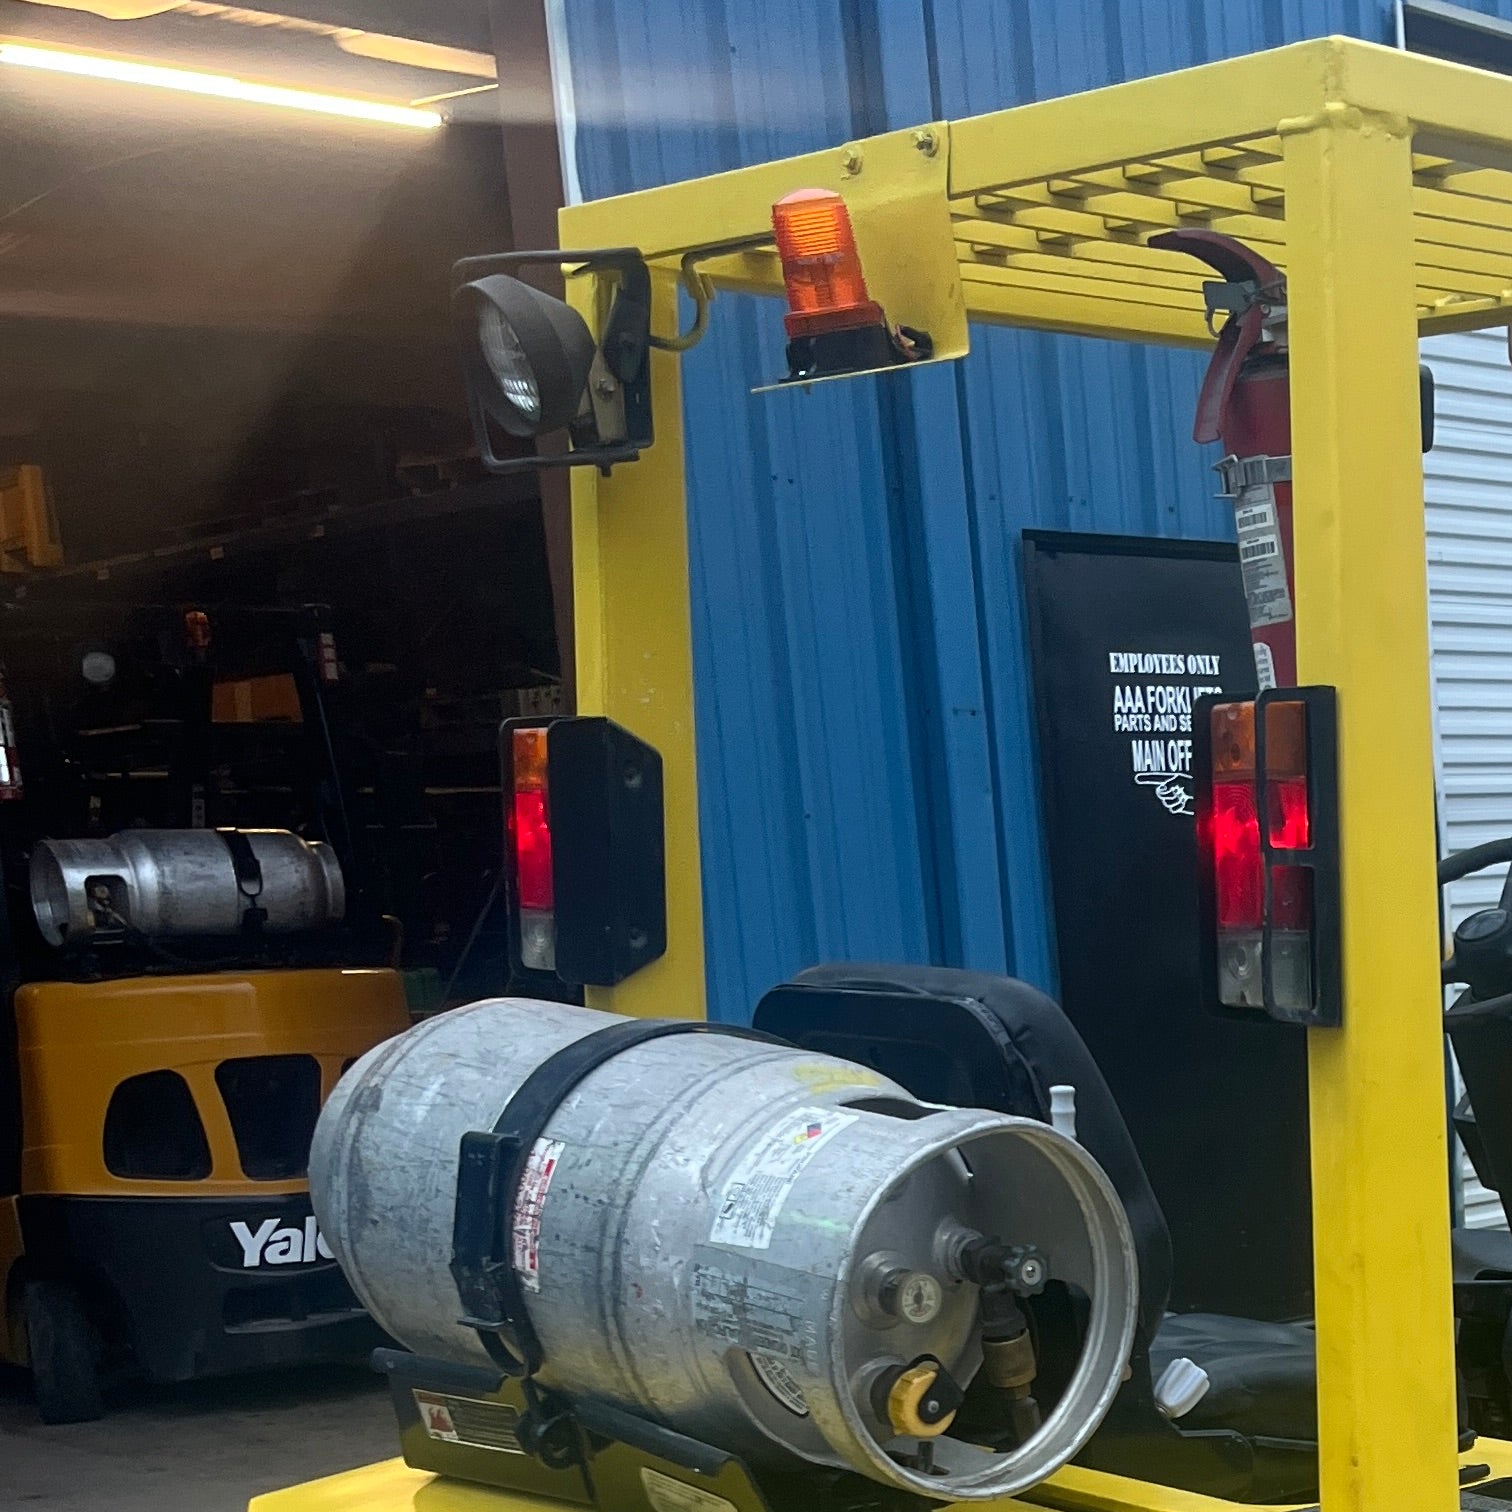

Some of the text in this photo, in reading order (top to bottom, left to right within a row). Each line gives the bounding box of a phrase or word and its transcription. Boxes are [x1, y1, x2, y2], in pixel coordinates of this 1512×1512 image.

[1109, 652, 1220, 675] EMPLOYEES ONLY
[1114, 685, 1146, 713] AAA
[1114, 714, 1152, 732] PARTS
[1153, 714, 1178, 732] AND
[1131, 739, 1192, 772] MAIN OFF
